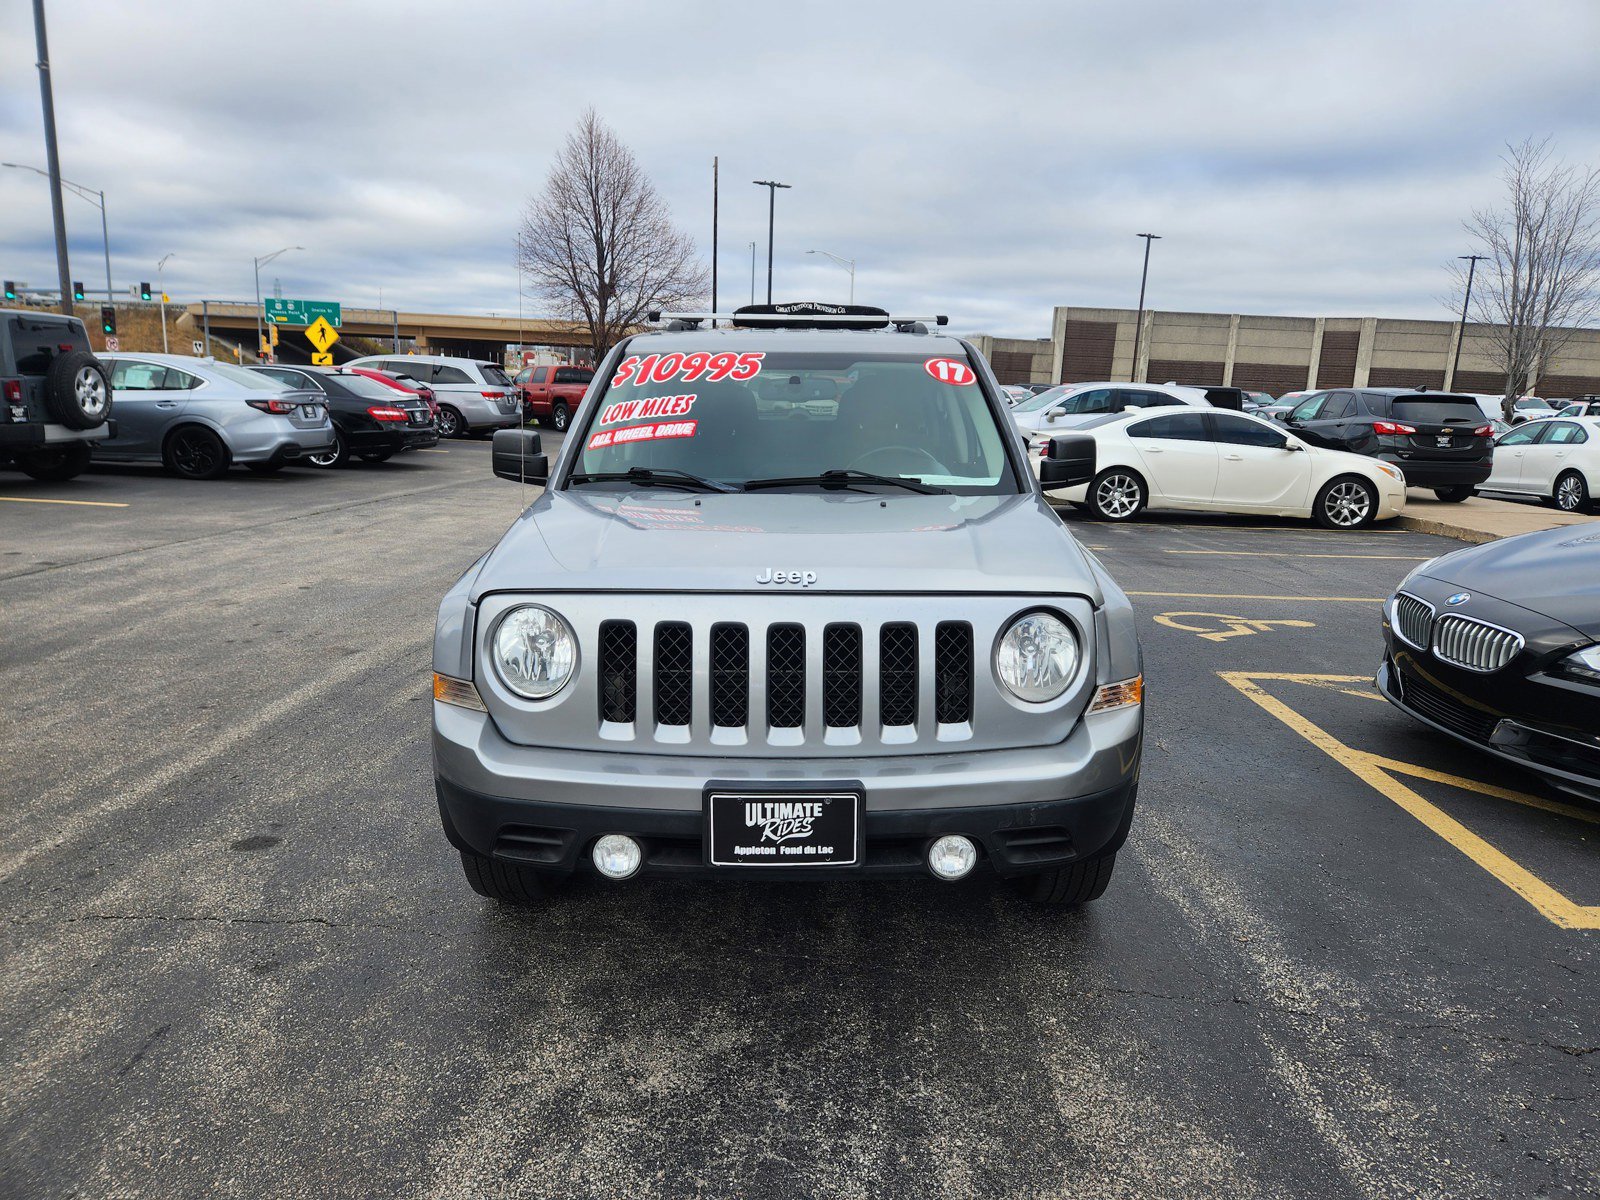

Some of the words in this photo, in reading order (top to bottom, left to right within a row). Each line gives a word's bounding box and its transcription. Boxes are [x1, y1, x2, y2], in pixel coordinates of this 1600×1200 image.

[611, 351, 767, 389] $10995
[936, 360, 966, 382] 17
[600, 399, 640, 426] LOW
[638, 394, 698, 420] MILES
[589, 433, 612, 449] ALL
[613, 426, 654, 443] WHEEL
[654, 422, 696, 438] DRIVE
[755, 567, 817, 588] Jeep
[745, 802, 823, 828] ULTIMATE
[734, 845, 777, 856] Appleton
[780, 845, 803, 855] Fond
[803, 845, 816, 855] du
[817, 845, 834, 854] Lac
